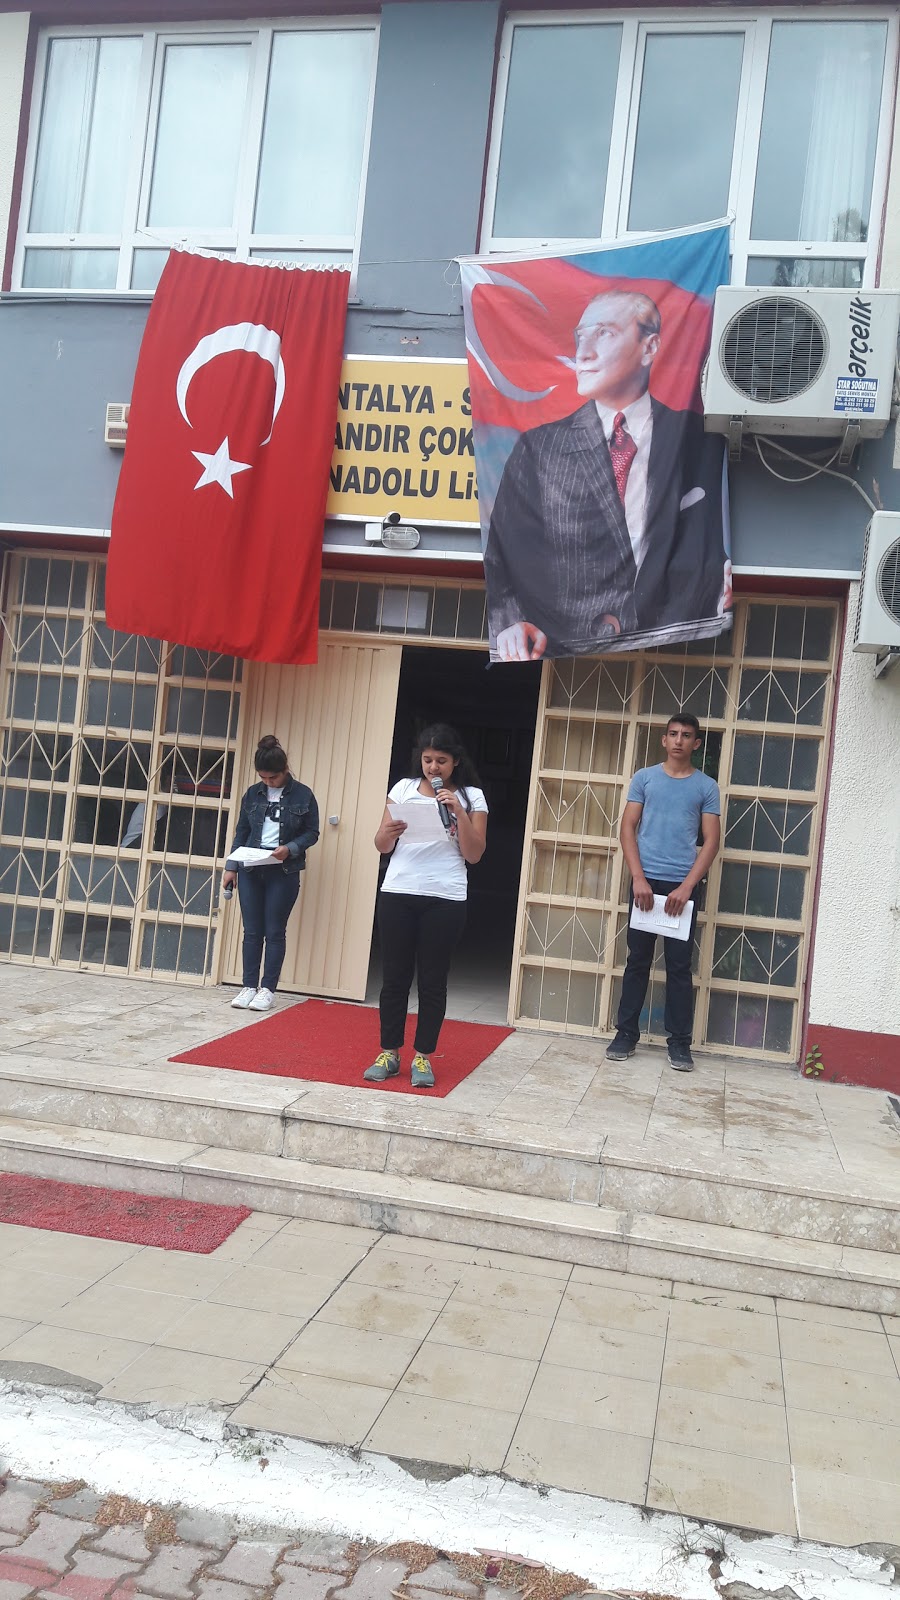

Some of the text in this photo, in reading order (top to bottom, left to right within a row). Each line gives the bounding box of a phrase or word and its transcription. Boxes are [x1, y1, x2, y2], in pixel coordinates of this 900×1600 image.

[848, 297, 873, 378] arçelik
[837, 379, 876, 390] STAR SOĞUTMA
[443, 400, 453, 408] -
[419, 426, 476, 461] ÇOK
